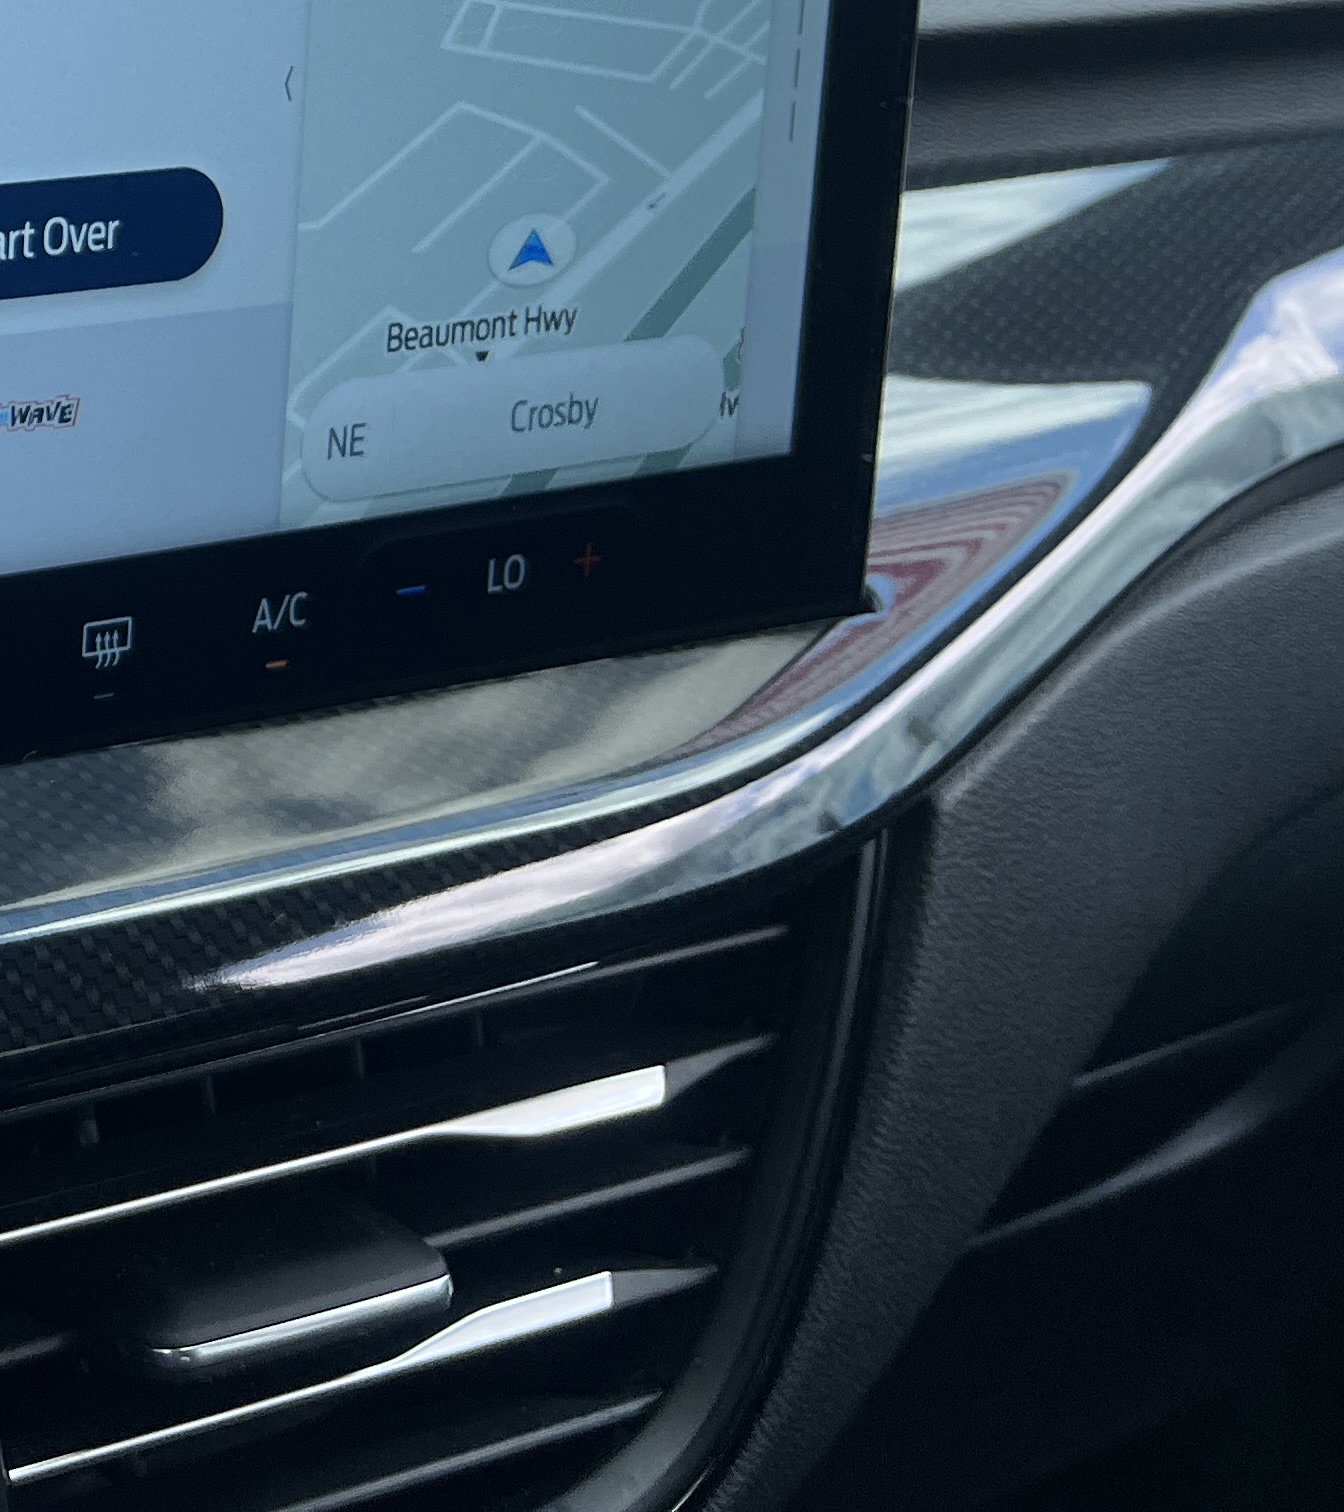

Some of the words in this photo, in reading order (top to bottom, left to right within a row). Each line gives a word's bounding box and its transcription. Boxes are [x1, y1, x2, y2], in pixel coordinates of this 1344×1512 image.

[43, 216, 120, 256] Over
[385, 311, 518, 354] Beaumont
[524, 305, 579, 336] Hwy
[510, 394, 599, 434] Crosby
[326, 422, 368, 461] NE
[487, 555, 526, 594] LO
[252, 593, 309, 634] A/C
